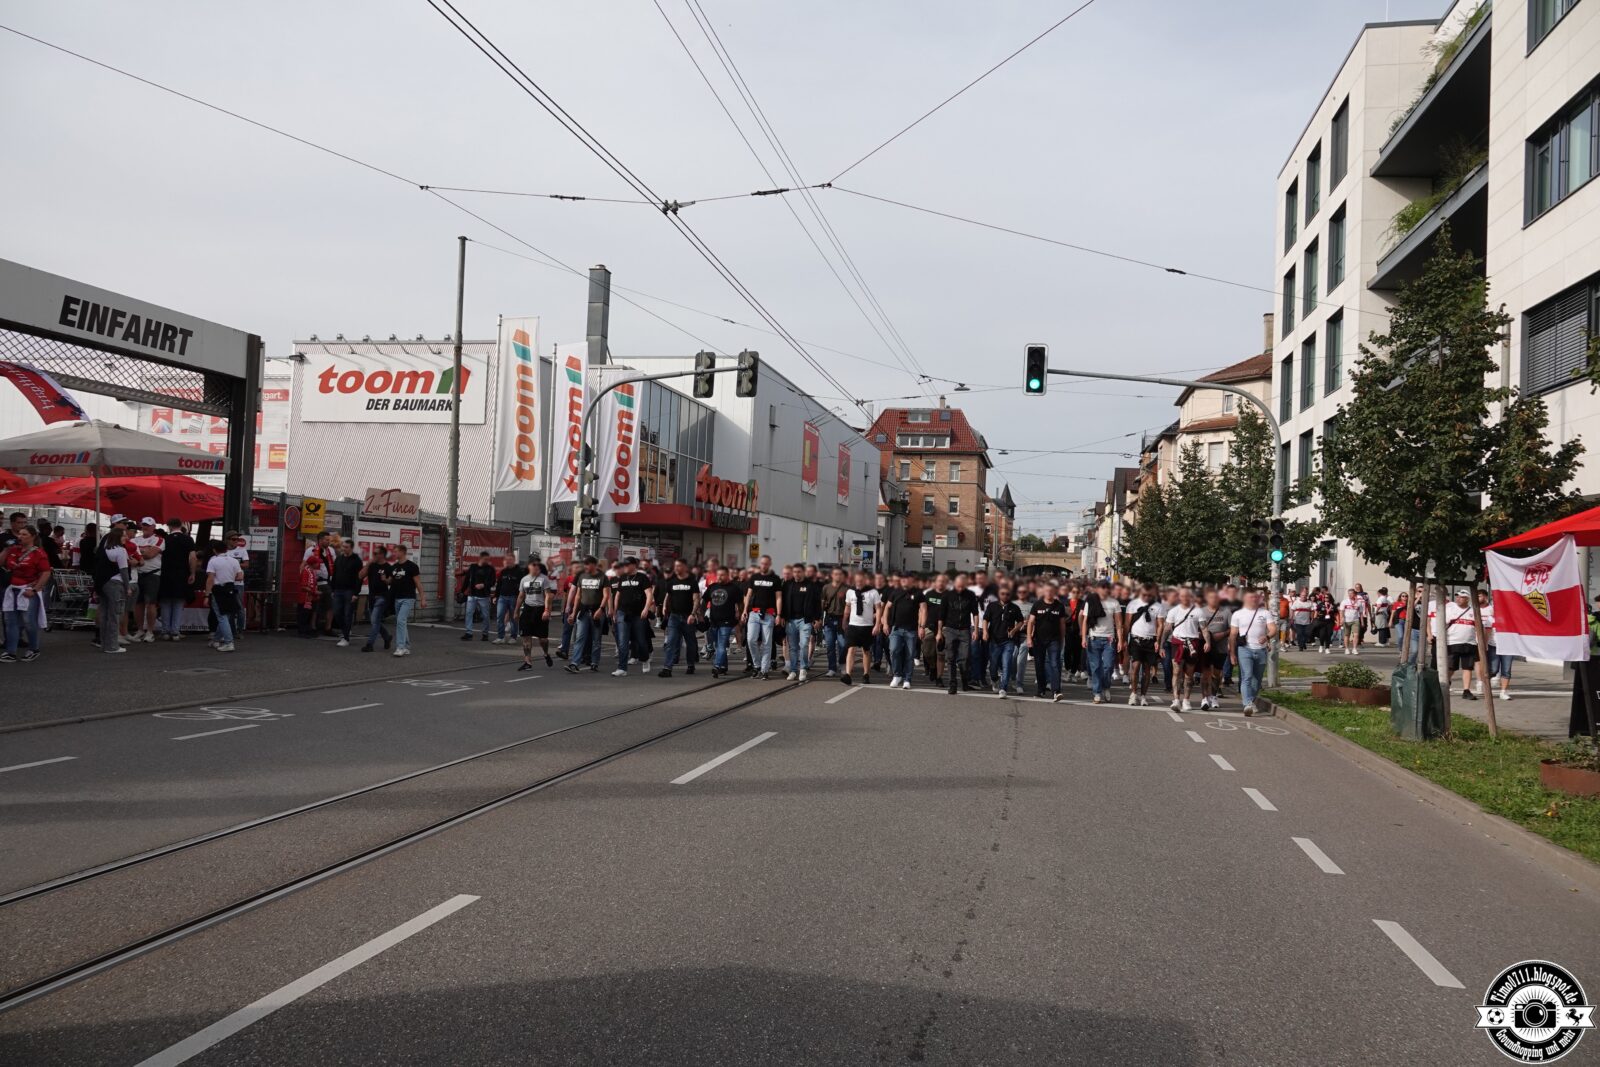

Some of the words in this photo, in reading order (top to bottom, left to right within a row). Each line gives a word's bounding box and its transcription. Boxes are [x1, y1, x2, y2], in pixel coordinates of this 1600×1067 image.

[59, 295, 193, 356] EINFAHRT
[318, 364, 435, 395] toom
[365, 398, 390, 411] DER
[509, 364, 536, 481] toom
[30, 451, 77, 465] toom
[563, 387, 583, 494] toom
[608, 409, 635, 507] toom
[177, 456, 215, 470] toom
[381, 488, 417, 519] Finca
[695, 463, 748, 511] toom
